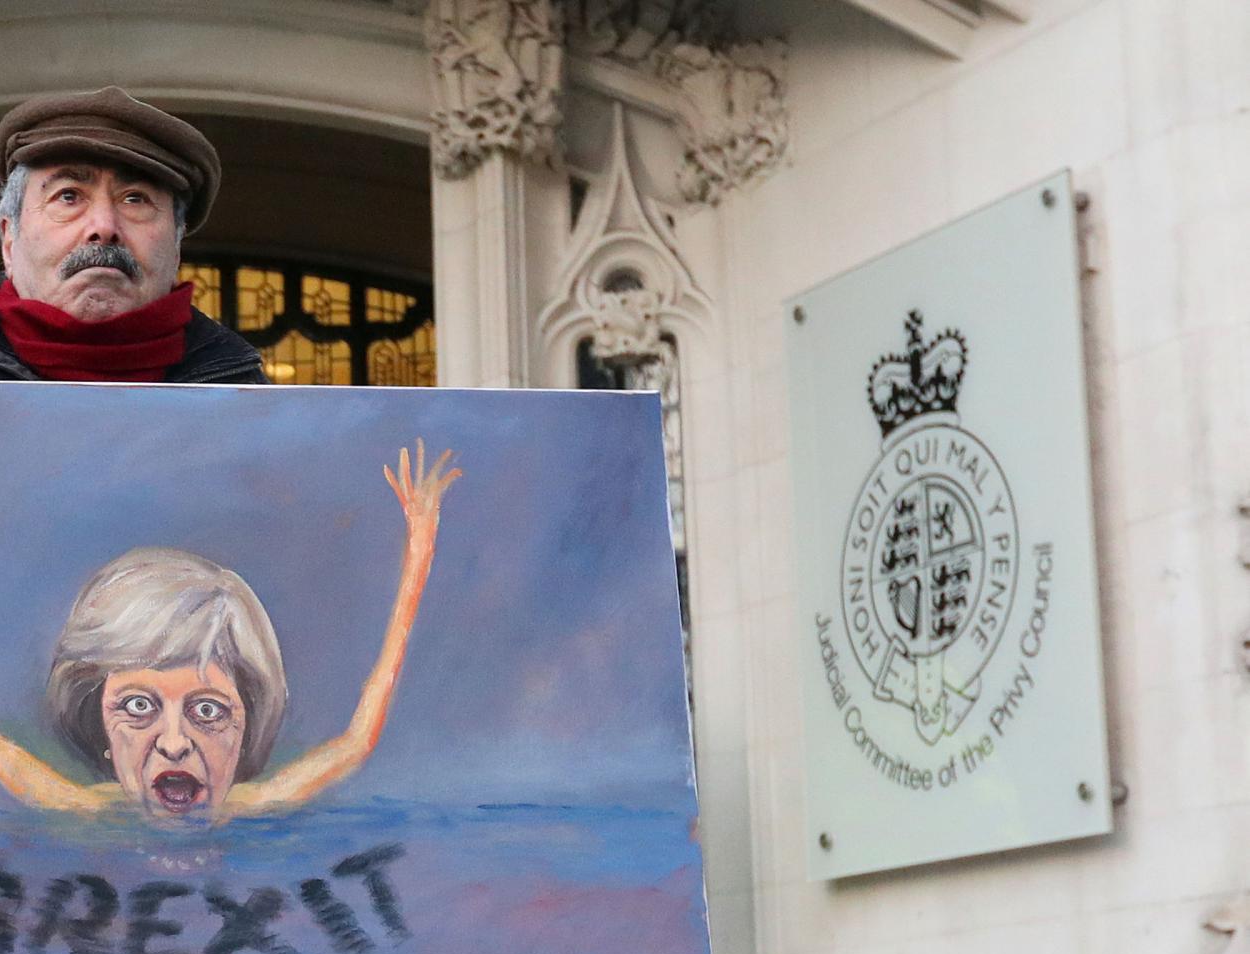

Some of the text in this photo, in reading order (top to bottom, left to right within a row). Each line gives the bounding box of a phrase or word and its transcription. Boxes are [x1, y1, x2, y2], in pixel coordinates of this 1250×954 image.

[815, 542, 1054, 791] Judicial Committee of the Privy Council
[849, 437, 1011, 660] HONI SOIT QUI MAL Y PENSE
